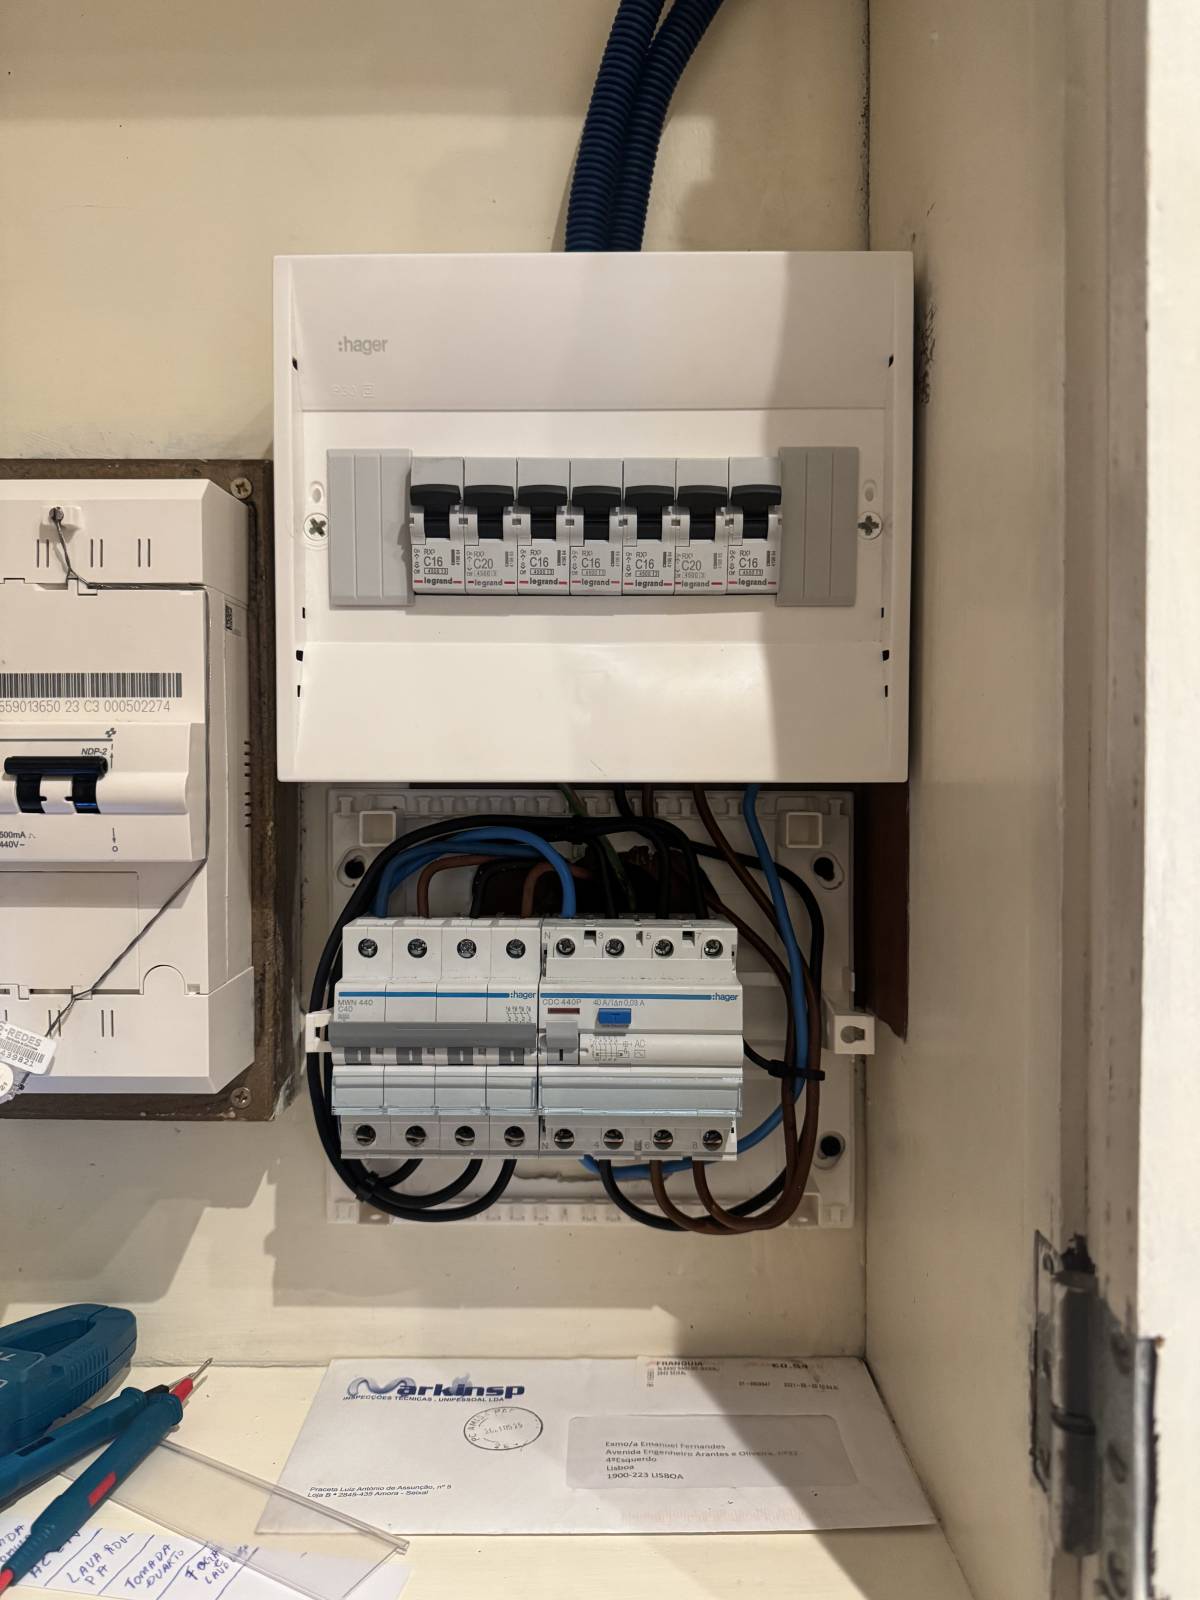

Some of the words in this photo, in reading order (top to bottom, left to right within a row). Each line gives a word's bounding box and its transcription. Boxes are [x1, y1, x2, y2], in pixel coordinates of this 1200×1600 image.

[424, 556, 443, 567] C16
[474, 558, 493, 569] C20
[530, 557, 549, 567] C16
[582, 558, 600, 568] C16
[636, 559, 654, 569] C16
[682, 560, 701, 571] C20
[739, 558, 758, 568] C16
[424, 577, 452, 585] legrand
[475, 579, 502, 587] legrand
[530, 577, 558, 586] legrand
[582, 579, 609, 587] legrand
[635, 579, 663, 588] legrand
[682, 580, 710, 588] legrand
[739, 578, 767, 587] legrand
[65, 701, 79, 712] 23
[84, 701, 99, 712] C3
[104, 701, 170, 712] 000502274
[66, 1552, 102, 1583] LAVA
[124, 1543, 171, 1590] TOMADA
